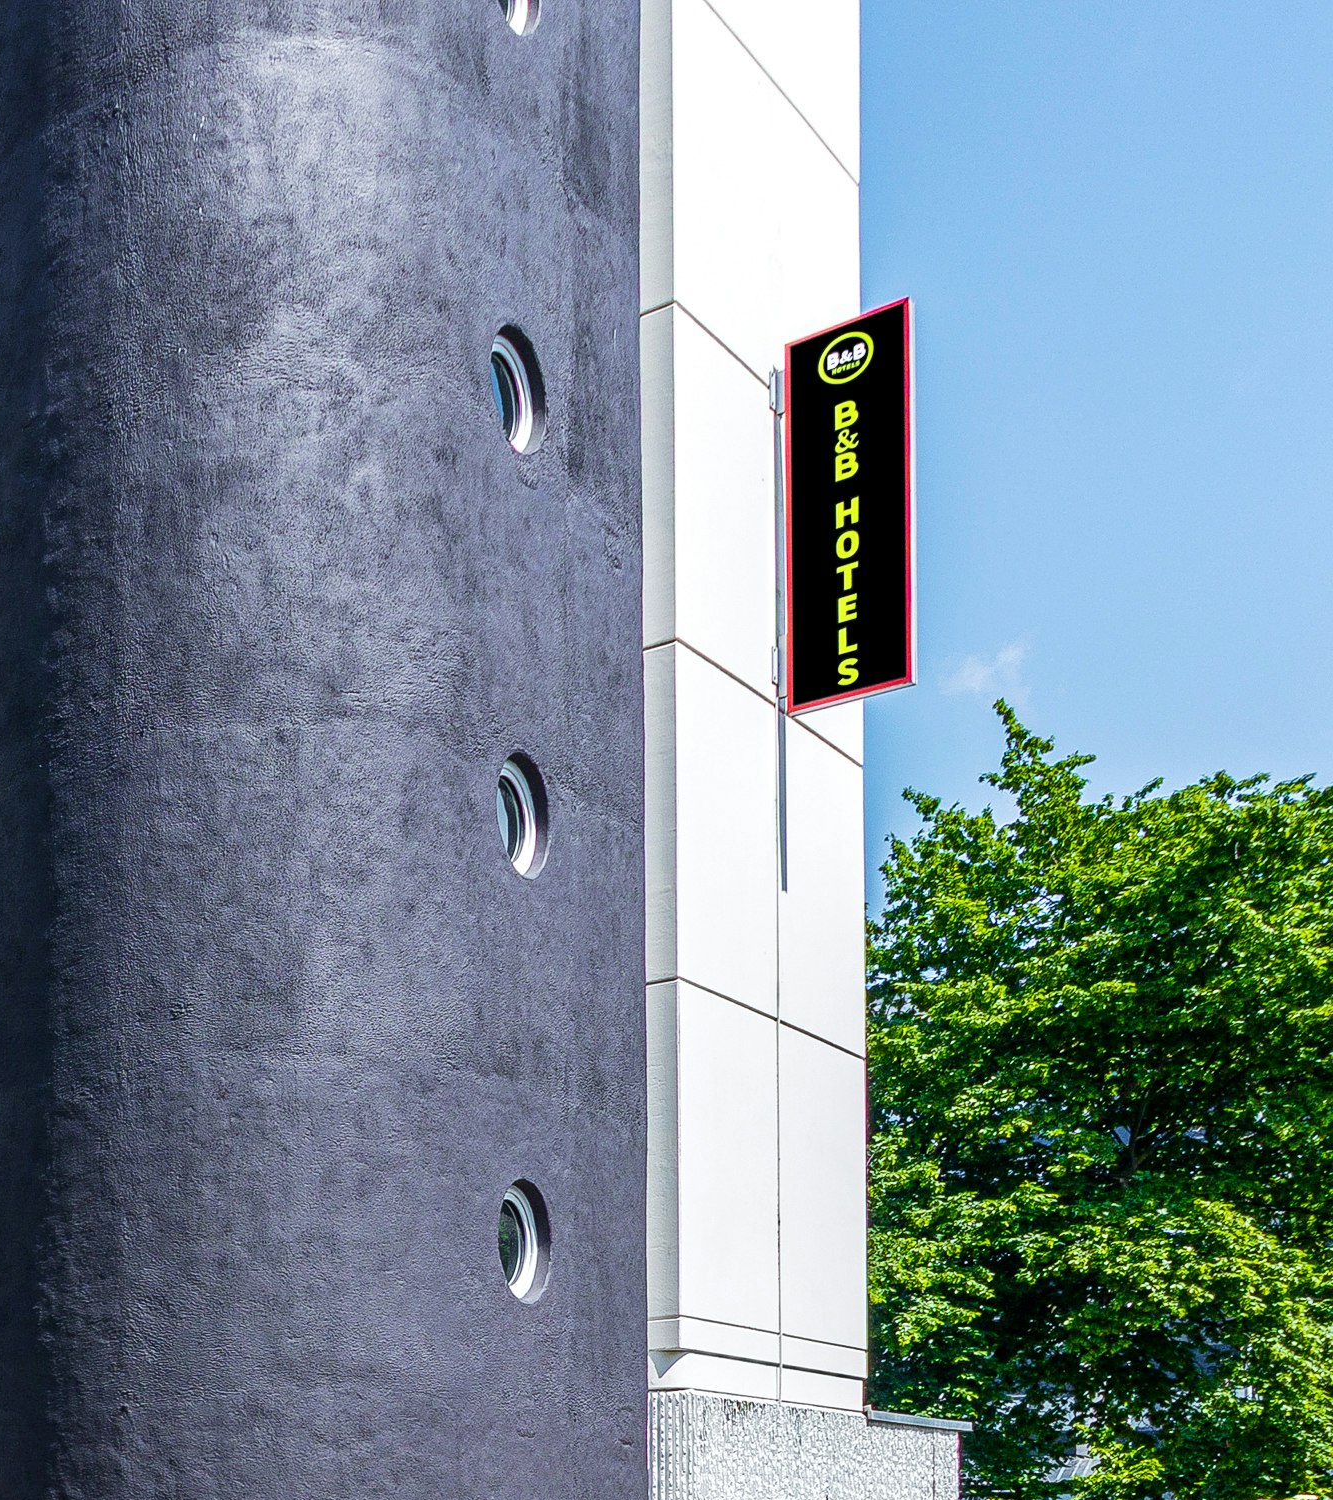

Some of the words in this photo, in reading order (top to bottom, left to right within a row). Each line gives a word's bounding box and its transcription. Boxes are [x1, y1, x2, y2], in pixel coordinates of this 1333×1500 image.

[826, 342, 867, 371] B&B
[831, 360, 861, 376] HOTELS
[834, 399, 859, 482] B&B
[835, 496, 860, 686] HOTELS
